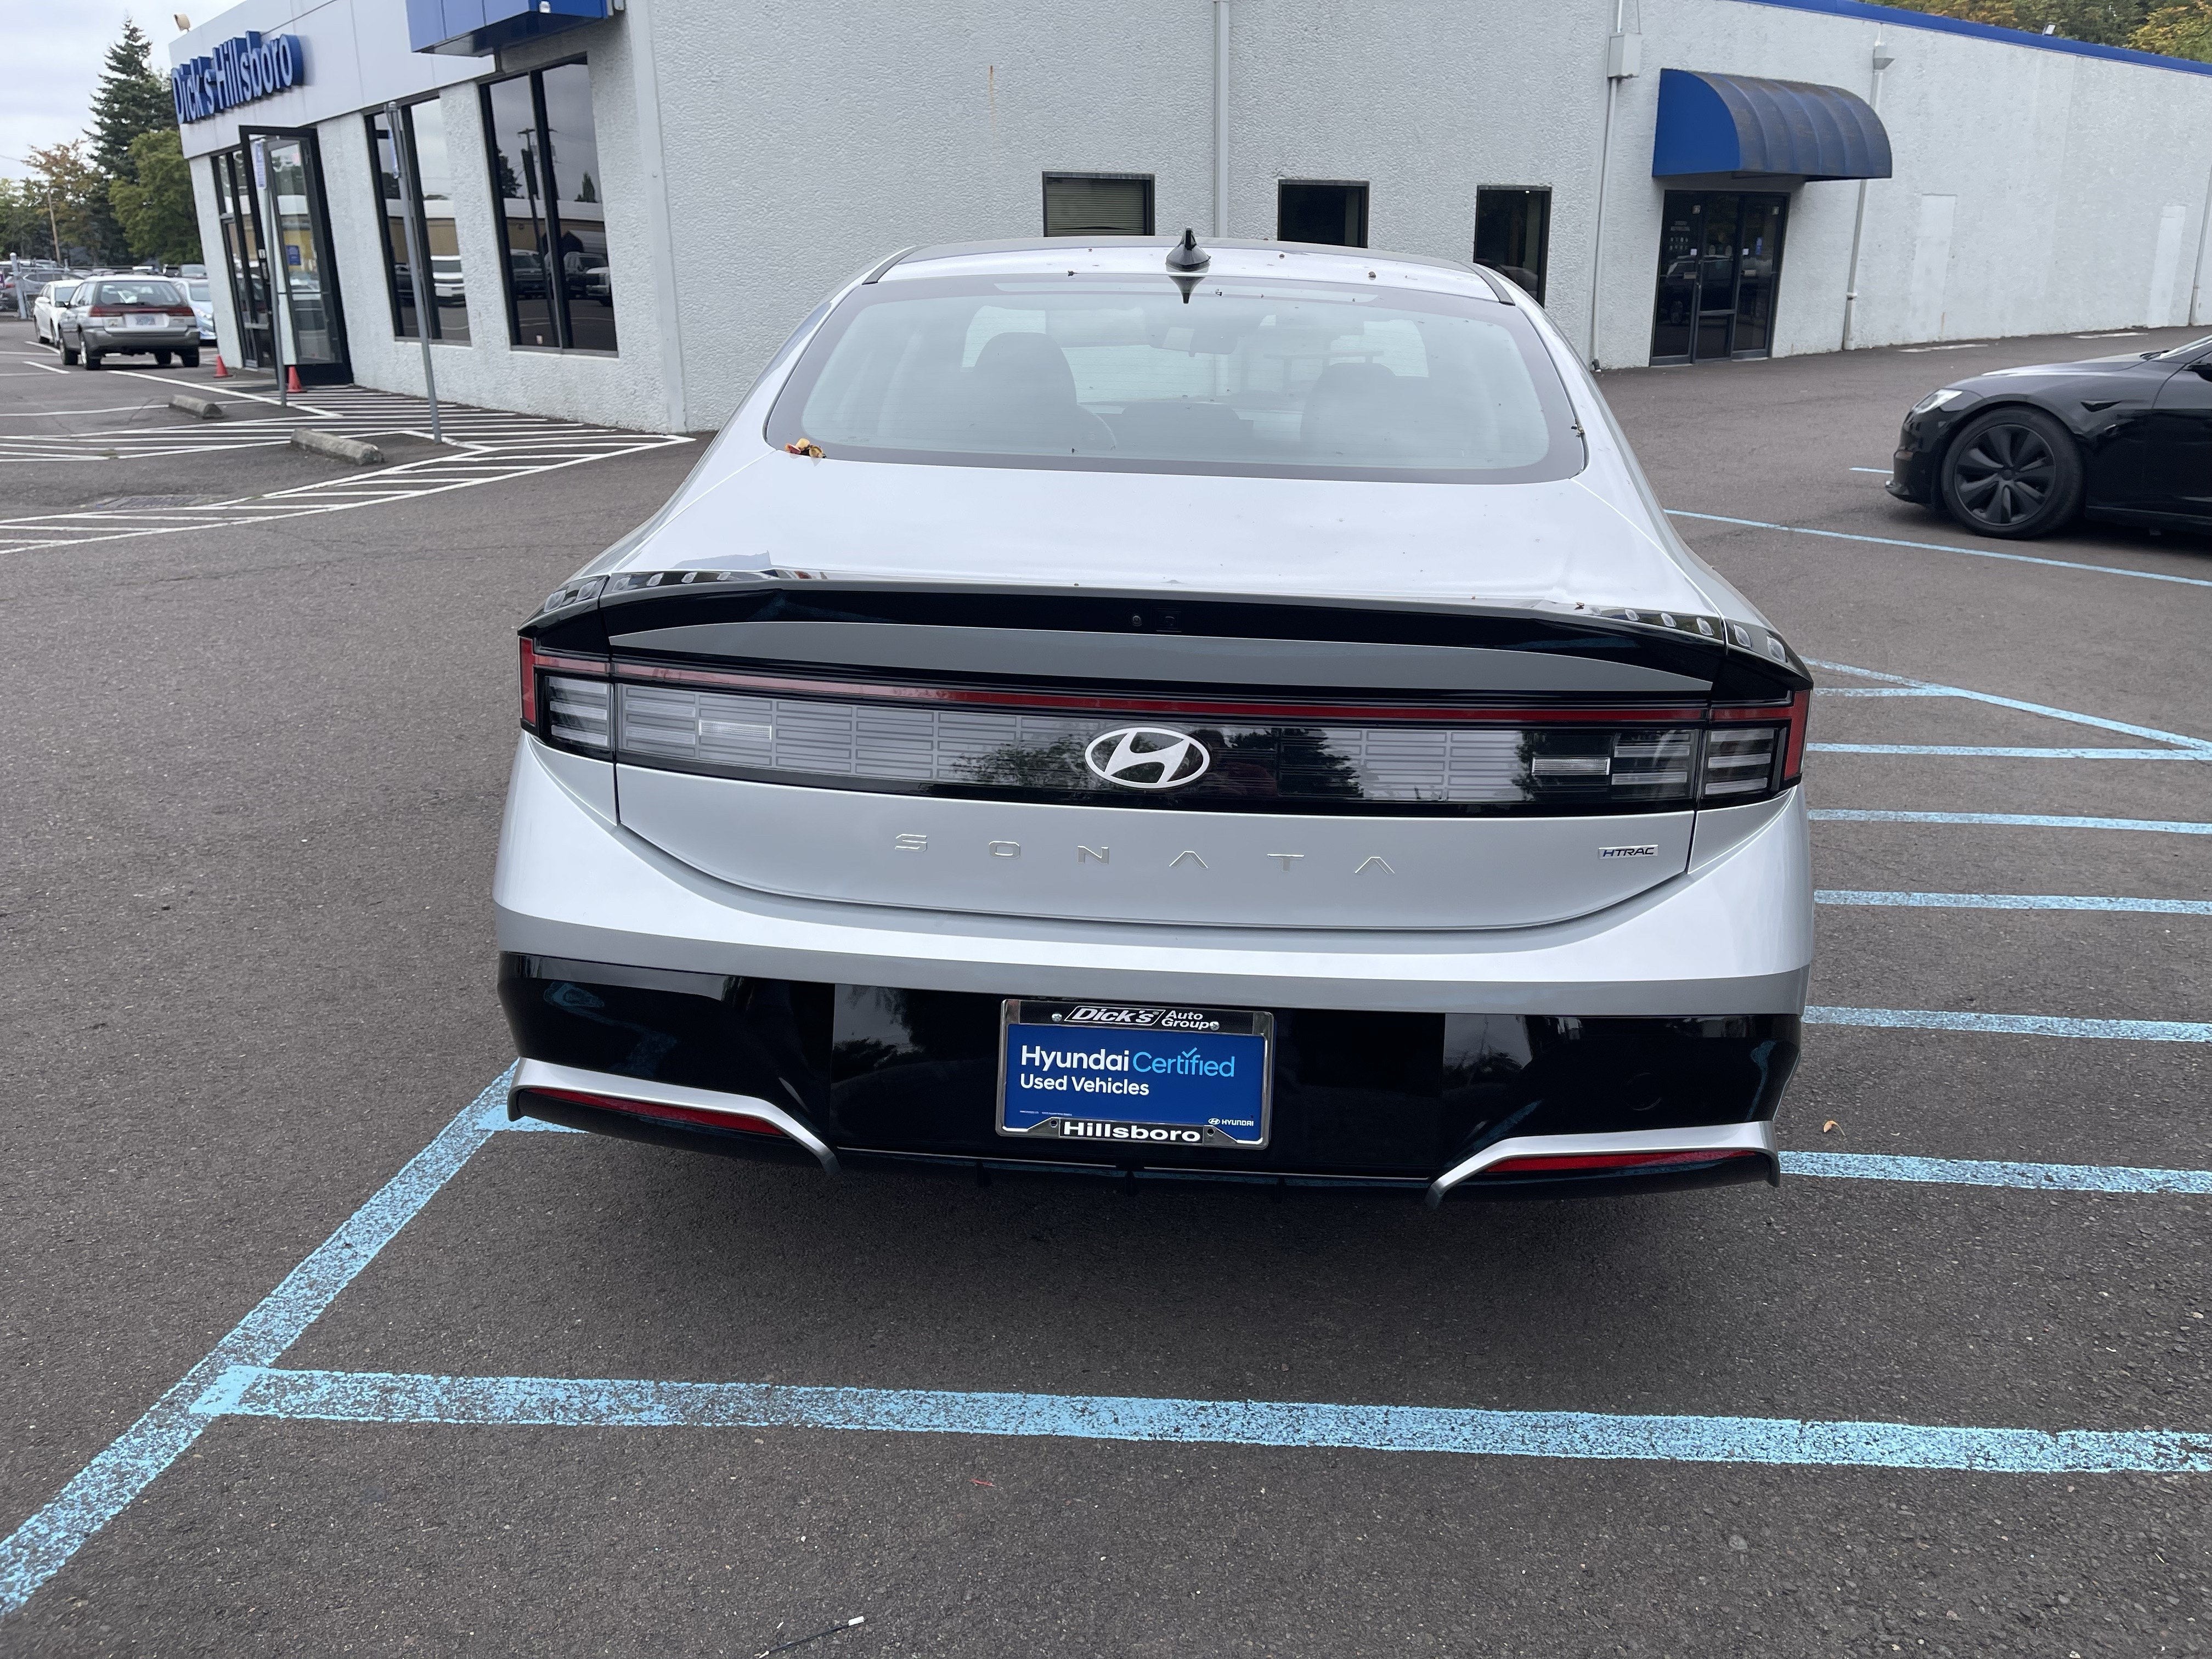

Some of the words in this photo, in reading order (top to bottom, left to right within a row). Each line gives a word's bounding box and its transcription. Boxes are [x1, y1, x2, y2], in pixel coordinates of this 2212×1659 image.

[171, 56, 216, 124] Dick's
[212, 31, 295, 110] Hillsboro
[894, 833, 1395, 874] SONATA
[1602, 847, 1655, 857] HTRAC
[1071, 1007, 1155, 1024] Dick's
[1161, 1017, 1210, 1030] Group
[1165, 1010, 1203, 1020] Auto
[1021, 1045, 1129, 1072] Hyundai
[1133, 1047, 1235, 1077] Certified
[1020, 1074, 1067, 1092] Used
[1071, 1076, 1149, 1096] Vehicles
[1063, 1122, 1201, 1143] Hillsboro
